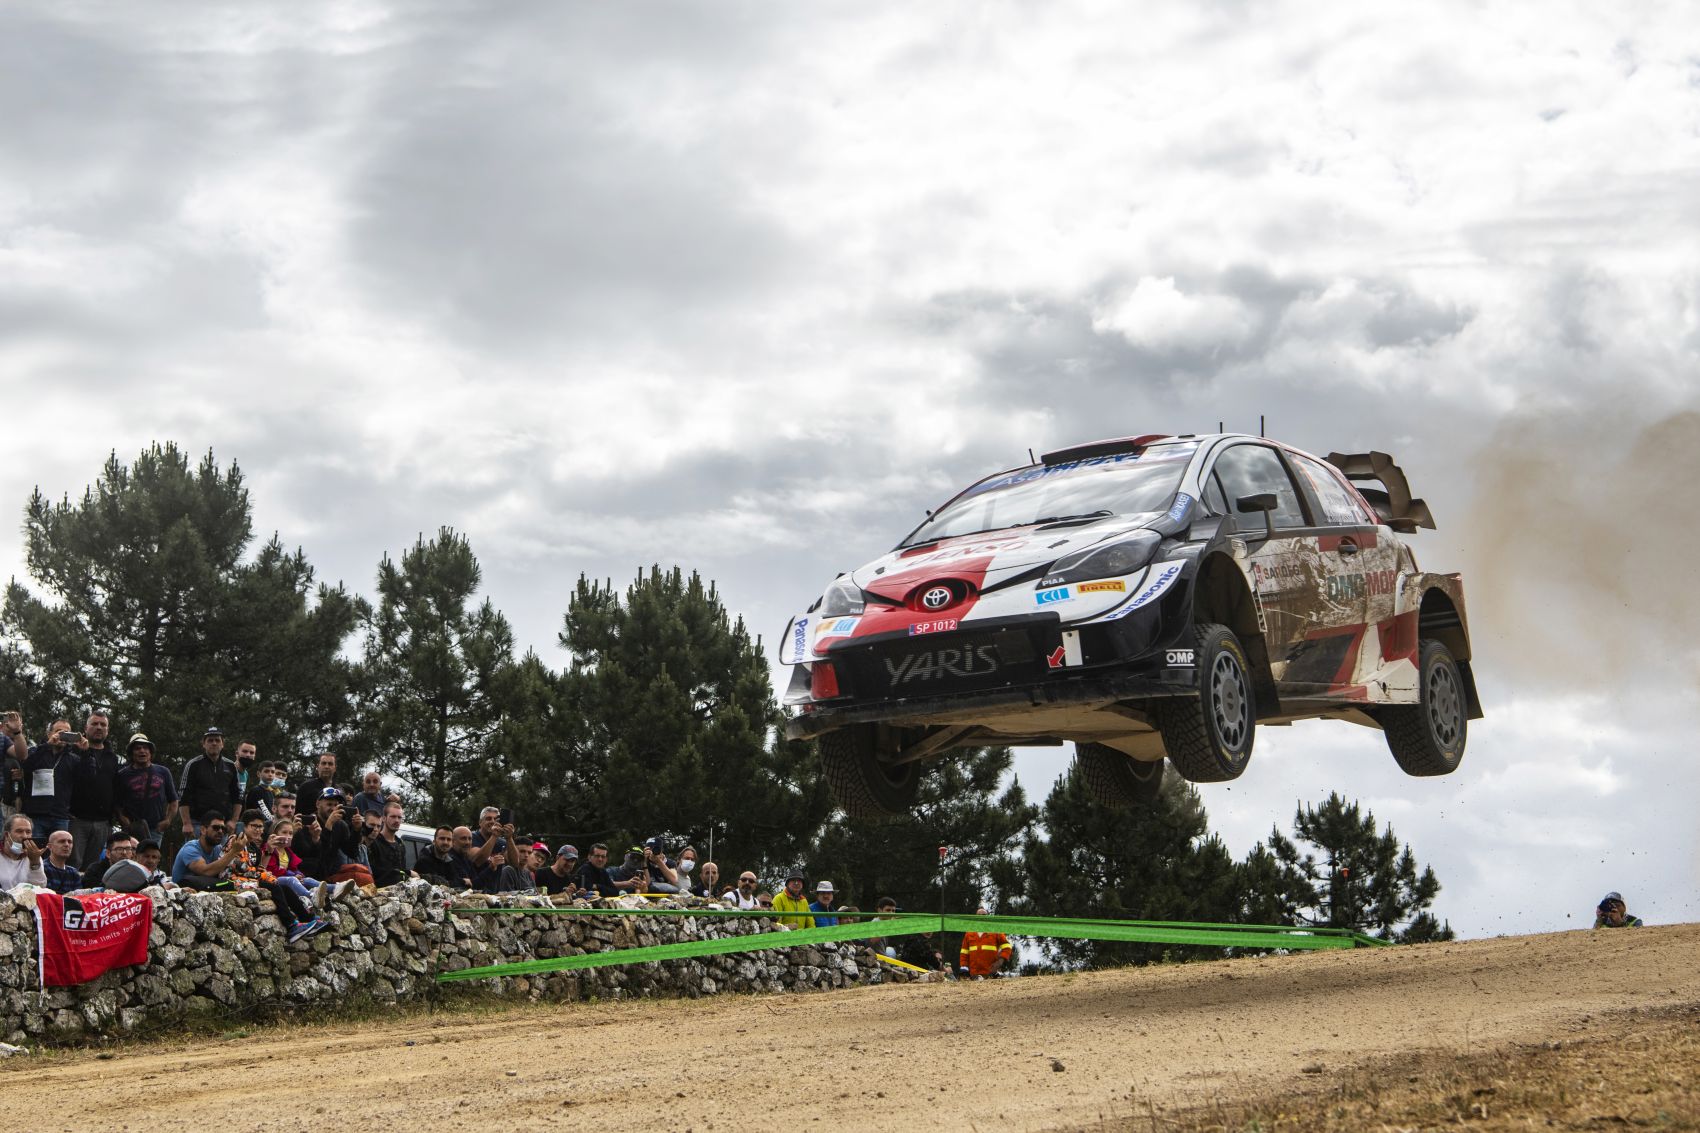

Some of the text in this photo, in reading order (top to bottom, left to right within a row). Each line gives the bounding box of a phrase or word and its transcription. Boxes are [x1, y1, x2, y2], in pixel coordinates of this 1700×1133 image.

[1042, 576, 1065, 587] PIAA
[1080, 581, 1122, 592] PIRELLI
[1104, 566, 1180, 620] Panasonic
[916, 619, 956, 634] SP 1012
[1166, 652, 1195, 664] OMP
[64, 910, 99, 929] GR
[100, 904, 142, 928] Racing
